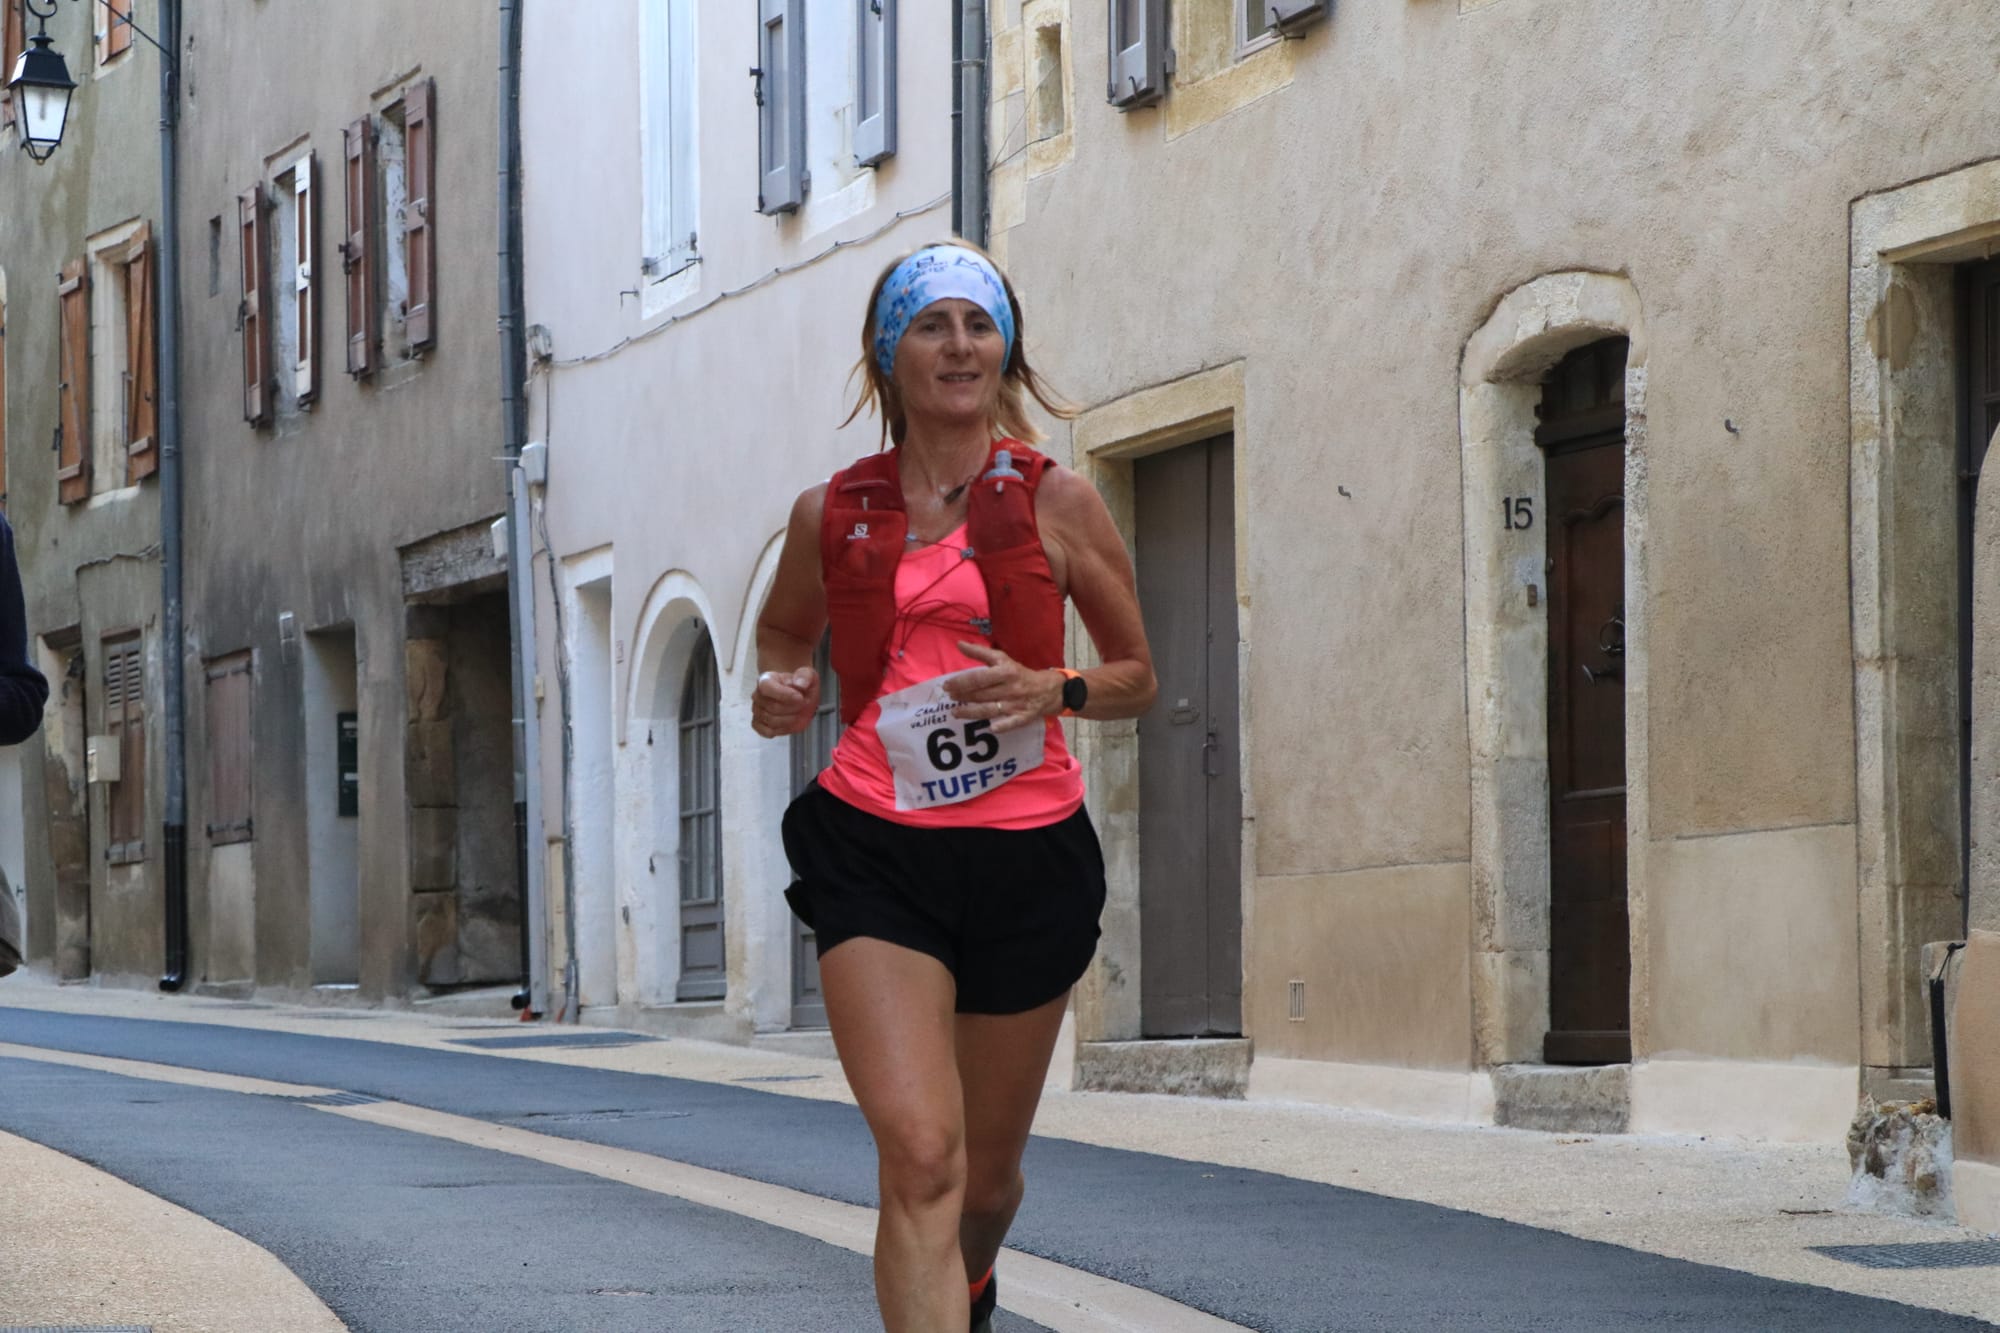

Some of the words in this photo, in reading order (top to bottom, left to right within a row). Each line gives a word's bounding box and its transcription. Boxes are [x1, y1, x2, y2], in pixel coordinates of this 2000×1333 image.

[1502, 497, 1533, 530] 15
[926, 719, 1000, 771] 65
[920, 758, 1018, 801] TUFF'S
